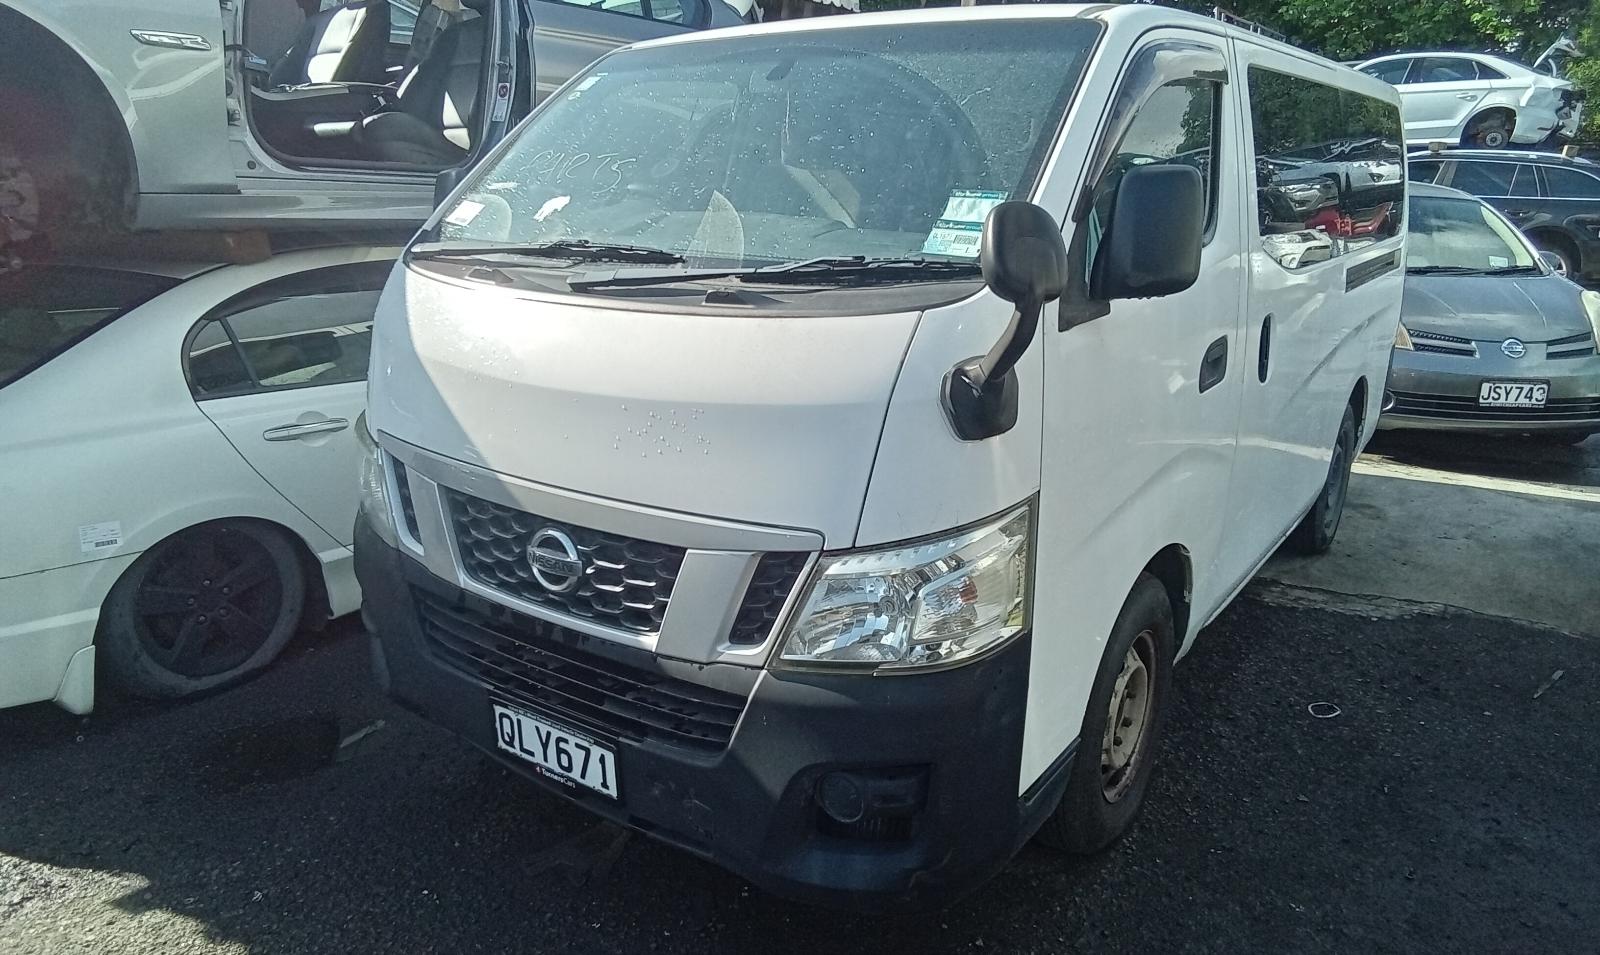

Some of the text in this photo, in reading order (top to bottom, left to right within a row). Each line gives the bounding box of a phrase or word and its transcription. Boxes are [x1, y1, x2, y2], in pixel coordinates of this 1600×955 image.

[1481, 385, 1546, 402] JSY743
[528, 549, 576, 574] NISSAN
[498, 711, 609, 790] QLY671
